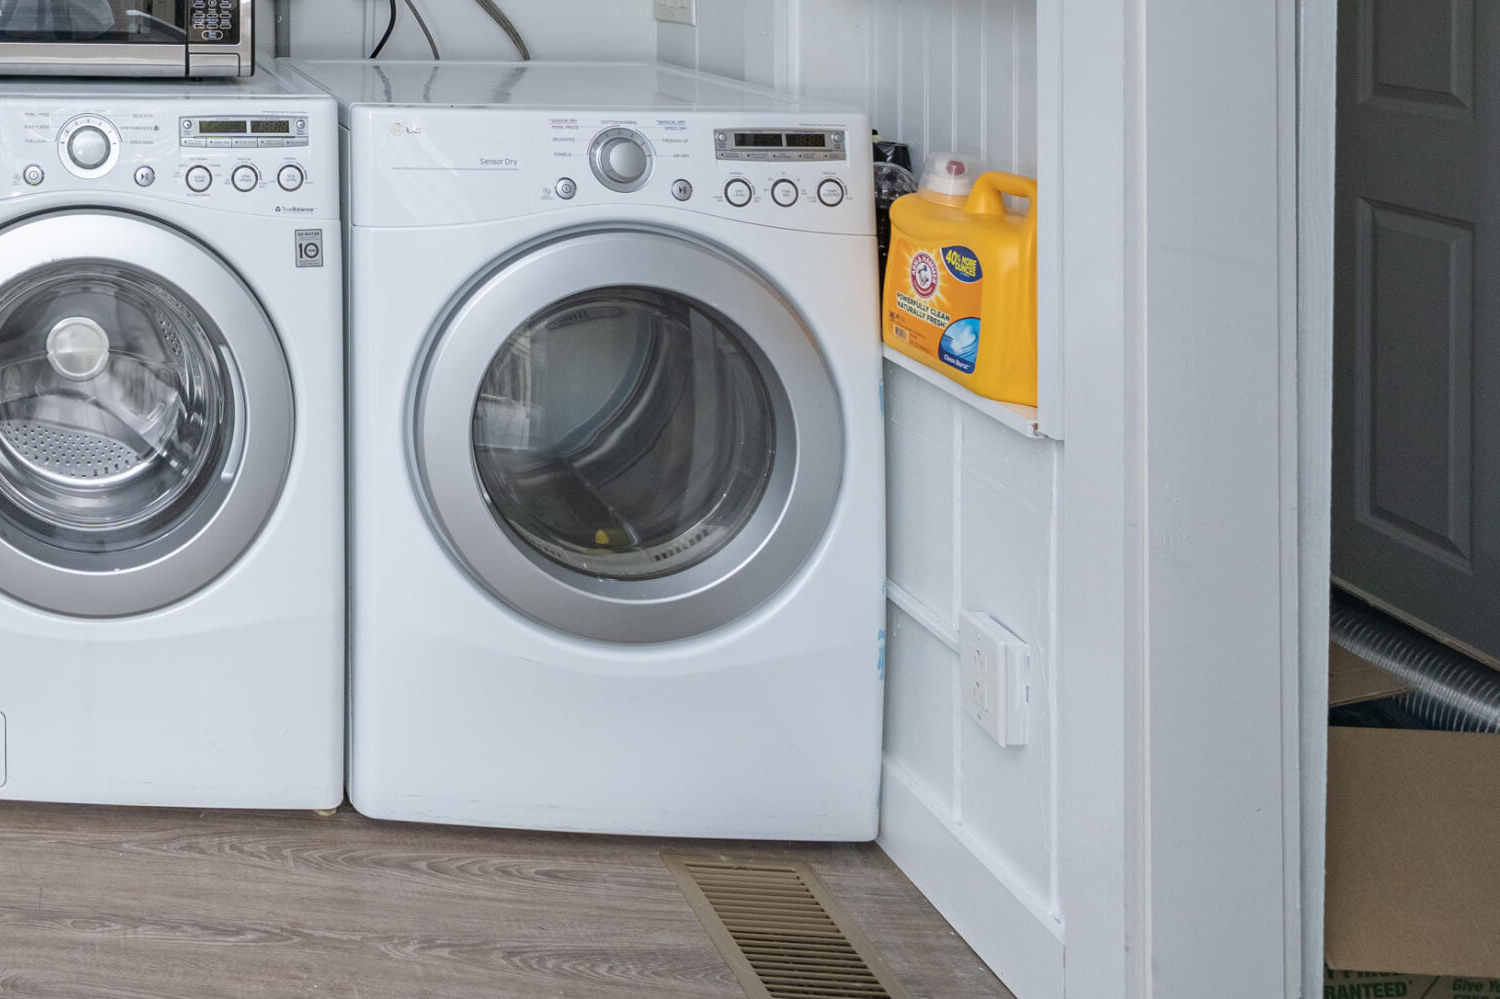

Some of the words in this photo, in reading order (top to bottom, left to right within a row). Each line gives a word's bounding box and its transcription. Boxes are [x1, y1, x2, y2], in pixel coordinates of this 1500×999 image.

[504, 157, 518, 167] Dry
[299, 242, 319, 259] 10
[961, 255, 977, 266] MORE
[954, 262, 977, 277] OUNCES
[896, 291, 930, 312] POWERFULLY
[930, 308, 950, 322] CLEAN
[897, 301, 927, 320] NATURALLY
[926, 314, 946, 328] FRESH
[1452, 977, 1485, 992] Give
